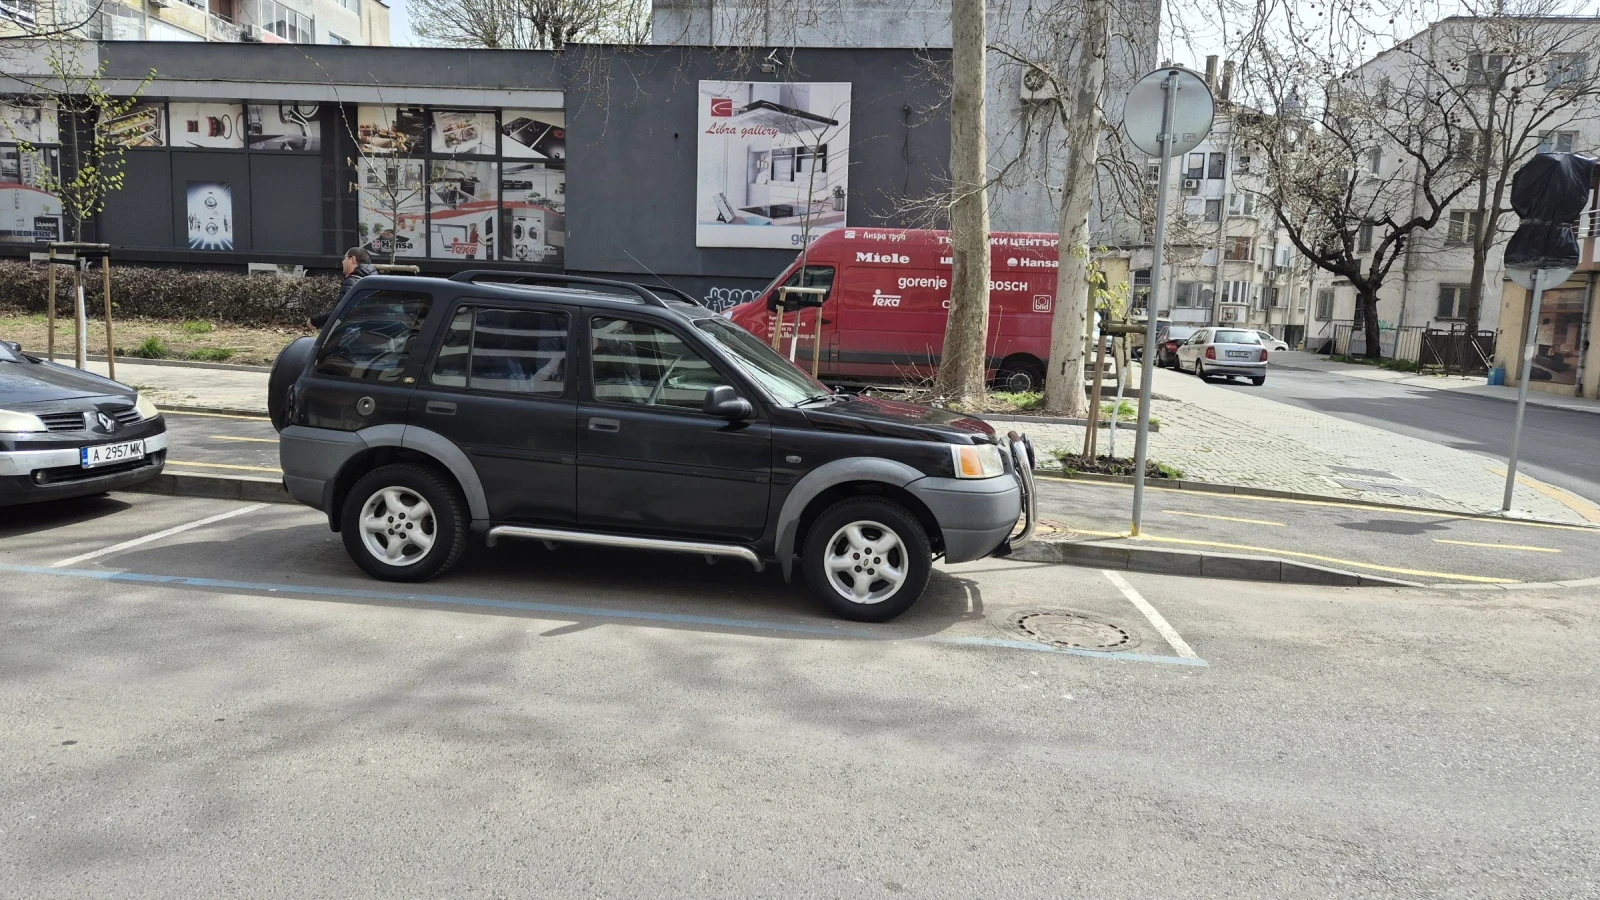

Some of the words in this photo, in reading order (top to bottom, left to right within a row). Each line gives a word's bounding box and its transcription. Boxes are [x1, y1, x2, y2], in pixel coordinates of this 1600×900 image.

[705, 122, 737, 135] Libra
[741, 124, 780, 139] gallery
[13, 230, 51, 238] LIEBHERR
[791, 233, 820, 246] gore
[1009, 238, 1059, 248] ЦЕНТЪР
[855, 252, 910, 263] Miele
[1020, 257, 1059, 268] Hansa
[898, 276, 947, 290] gorenje
[989, 280, 1028, 292] BOSCH
[93, 448, 100, 461] A
[105, 444, 129, 460] 2957
[130, 442, 142, 456] MK
